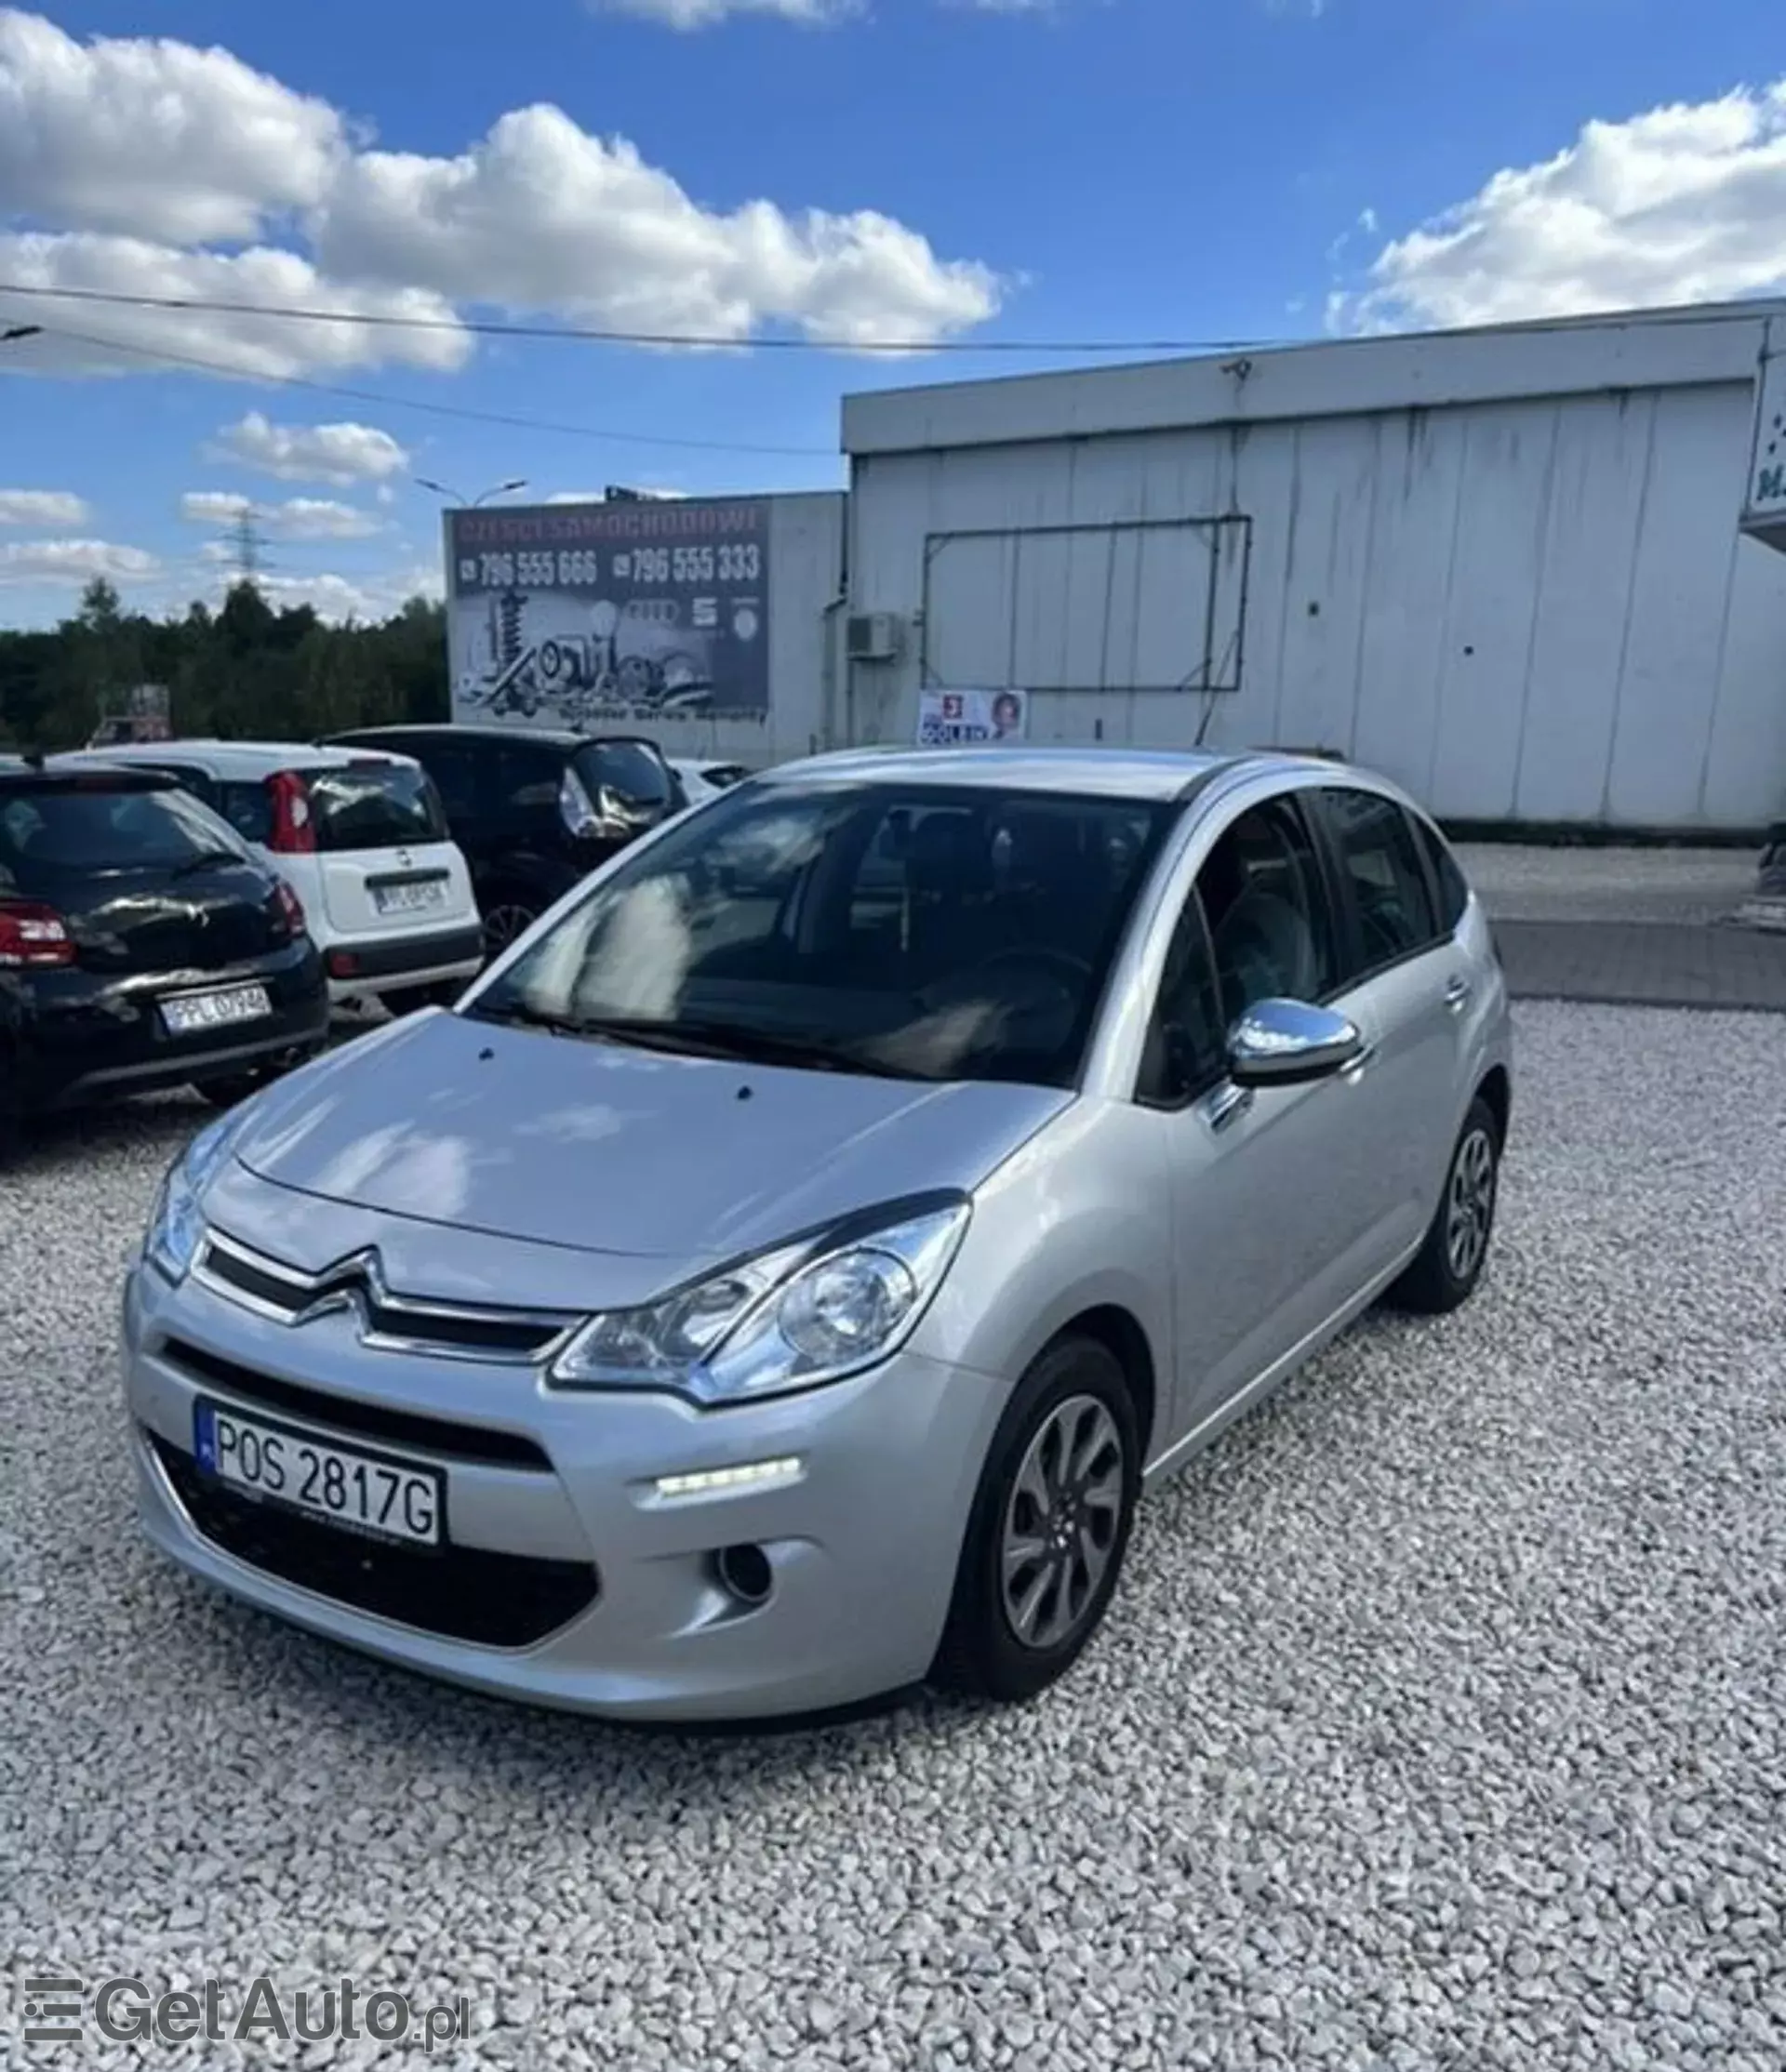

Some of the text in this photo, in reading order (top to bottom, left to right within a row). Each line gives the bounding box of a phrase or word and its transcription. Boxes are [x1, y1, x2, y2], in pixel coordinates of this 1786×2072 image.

[478, 550, 597, 587] 796 555 666
[632, 543, 760, 582] 796 555 333
[217, 1420, 285, 1489] POS
[298, 1450, 433, 1534] 2817G
